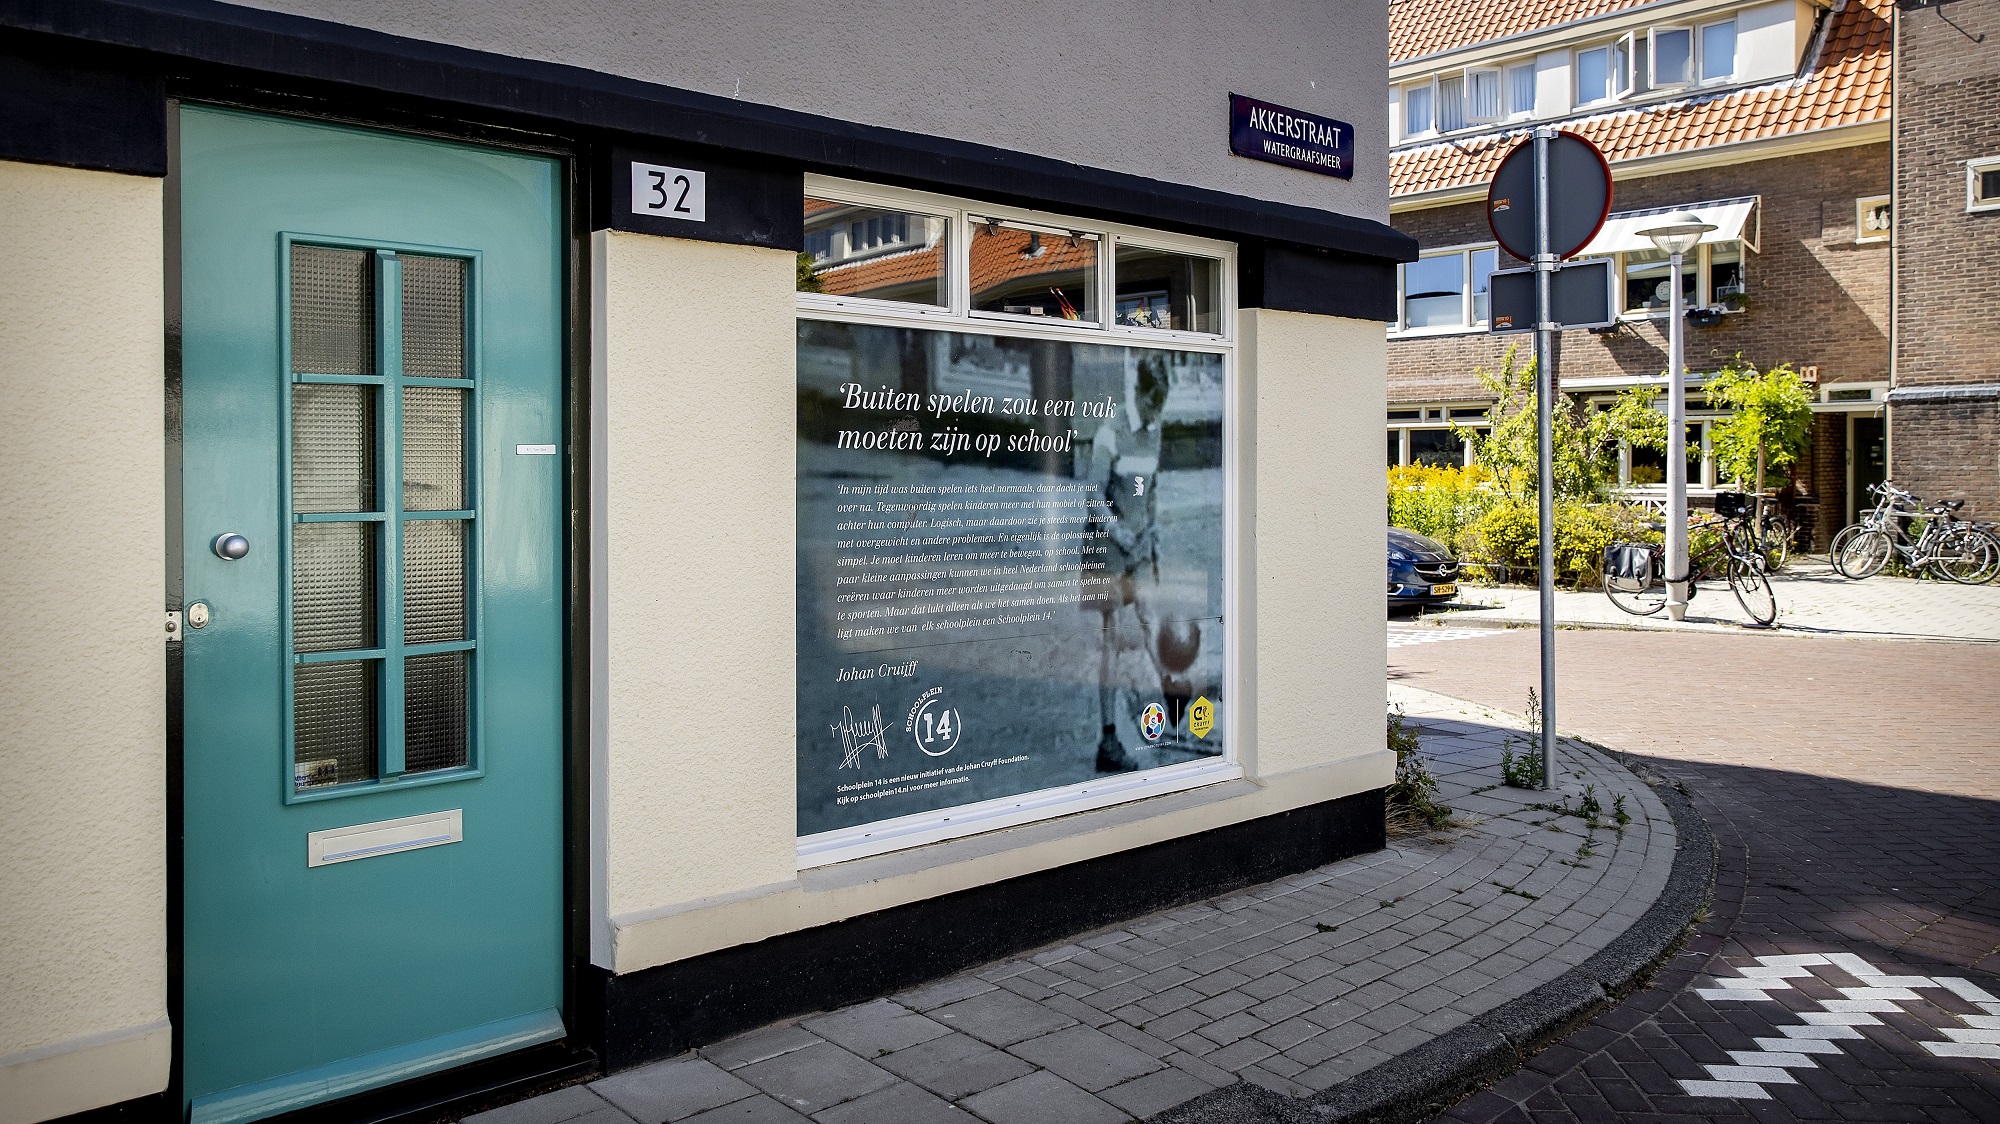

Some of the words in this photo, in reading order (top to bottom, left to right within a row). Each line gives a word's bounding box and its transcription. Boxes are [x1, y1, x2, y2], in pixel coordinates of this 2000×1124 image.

[1249, 106, 1341, 149] AKKERSTRAAT
[1263, 139, 1341, 169] WATERGRAAFSMEER
[648, 170, 691, 213] 32
[927, 389, 994, 418] spelen
[1000, 397, 1039, 416] zou
[1043, 398, 1076, 417] een
[1081, 397, 1117, 419] vak
[837, 427, 924, 450] moeten
[930, 426, 971, 456] zijn
[975, 433, 1001, 457] op
[852, 484, 871, 496] mijn
[874, 484, 889, 495] tijd
[891, 486, 908, 494] was
[910, 484, 936, 494] buiten
[938, 484, 962, 495] spelen
[965, 484, 978, 493] iets
[980, 484, 995, 493] heel
[997, 484, 1035, 494] normaals,
[1037, 483, 1055, 492] daar
[1056, 483, 1076, 492] dacht
[1077, 484, 1083, 493] je
[1085, 483, 1098, 492] niet
[837, 504, 857, 513] over
[860, 504, 873, 512] na.
[876, 501, 936, 513] Tegenwoordig
[938, 501, 962, 512] spelen
[965, 500, 998, 510] kinderen
[1000, 501, 1019, 509] meer
[1021, 500, 1035, 509] met
[1036, 500, 1050, 508] hun
[1052, 499, 1076, 508] mobiel
[1078, 499, 1086, 508] of
[1086, 498, 1105, 507] zitten
[837, 520, 866, 530] achter
[868, 519, 885, 529] hun
[887, 519, 928, 530] computer.
[930, 518, 963, 529] Logisch,
[966, 519, 988, 527] maar
[989, 517, 1025, 526] daardoor
[1028, 516, 1038, 524] zie
[1039, 516, 1046, 525] je
[1047, 515, 1068, 524] steeds
[1069, 516, 1088, 524] meer
[1089, 514, 1118, 523] kinderen
[837, 539, 854, 549] met
[856, 537, 909, 549] overgewicht
[922, 535, 951, 545] andere
[952, 534, 996, 546] problemen.
[998, 533, 1008, 542] En
[1010, 532, 1041, 543] eigenlijk
[1043, 532, 1049, 540] is
[1051, 531, 1060, 539] de
[1061, 530, 1094, 541] oplossing
[1095, 529, 1109, 538] heel
[837, 556, 868, 568] simpel.
[870, 555, 880, 565] Je
[882, 555, 902, 564] moet
[905, 553, 941, 563] kinderen
[943, 552, 963, 561] leren
[965, 552, 978, 560] om
[979, 551, 999, 559] meer
[1000, 550, 1007, 558] te
[1009, 549, 1042, 559] bewegen,
[1044, 549, 1054, 558] op
[1081, 546, 1095, 554] Met
[1095, 546, 1107, 554] een
[837, 575, 860, 586] paar
[861, 573, 887, 583] kleine
[889, 570, 947, 582] aanpassingen
[948, 569, 978, 578] kunnen
[980, 568, 992, 576] we
[993, 566, 1001, 575] in
[1002, 565, 1018, 575] heel
[1019, 563, 1058, 574] Nederland
[1059, 561, 1106, 572] schoolpleinen
[837, 592, 869, 603] creëren
[872, 590, 896, 600] waar
[897, 588, 934, 599] kinderen
[936, 587, 956, 596] meer
[958, 584, 988, 594] worden
[990, 581, 1033, 593] uitgedaagd
[1047, 579, 1071, 588] samen
[1072, 578, 1079, 586] te
[1080, 576, 1101, 587] spelen
[837, 611, 845, 620] te
[847, 609, 882, 622] sporten.
[885, 606, 910, 617] Maar
[911, 605, 926, 615] dat
[927, 603, 943, 613] lukt
[945, 601, 969, 612] alleen
[971, 600, 982, 610] als
[984, 601, 996, 609] we
[997, 599, 1009, 608] het
[1011, 598, 1035, 606] samen
[1036, 595, 1056, 605] doen.
[1057, 593, 1068, 603] Als
[1070, 592, 1080, 601] het
[1082, 593, 1096, 601] aan
[1097, 590, 1109, 601] mij
[837, 629, 853, 640] ligt
[854, 626, 884, 637] maken
[887, 626, 899, 634] we
[901, 624, 917, 633] van
[921, 621, 934, 631] elk
[936, 617, 981, 630] schoolplein
[982, 617, 995, 626] een
[997, 612, 1040, 625] Schoolplein
[836, 667, 874, 682] Johan
[878, 660, 919, 677] Cruijff
[905, 686, 943, 732] SCHOOLPLEIN
[923, 709, 952, 743] 14
[837, 780, 873, 793] Schoolplein
[901, 774, 919, 782] nieuw
[920, 767, 944, 779] initiatief
[963, 763, 980, 771] Johan
[981, 759, 997, 768] Cruyff
[998, 755, 1030, 765] Foundation.
[836, 797, 849, 805] Kijk
[859, 785, 908, 801] schoolplein14.nl
[909, 784, 923, 792] voor
[924, 781, 939, 789] meer
[940, 775, 970, 786] informatie.
